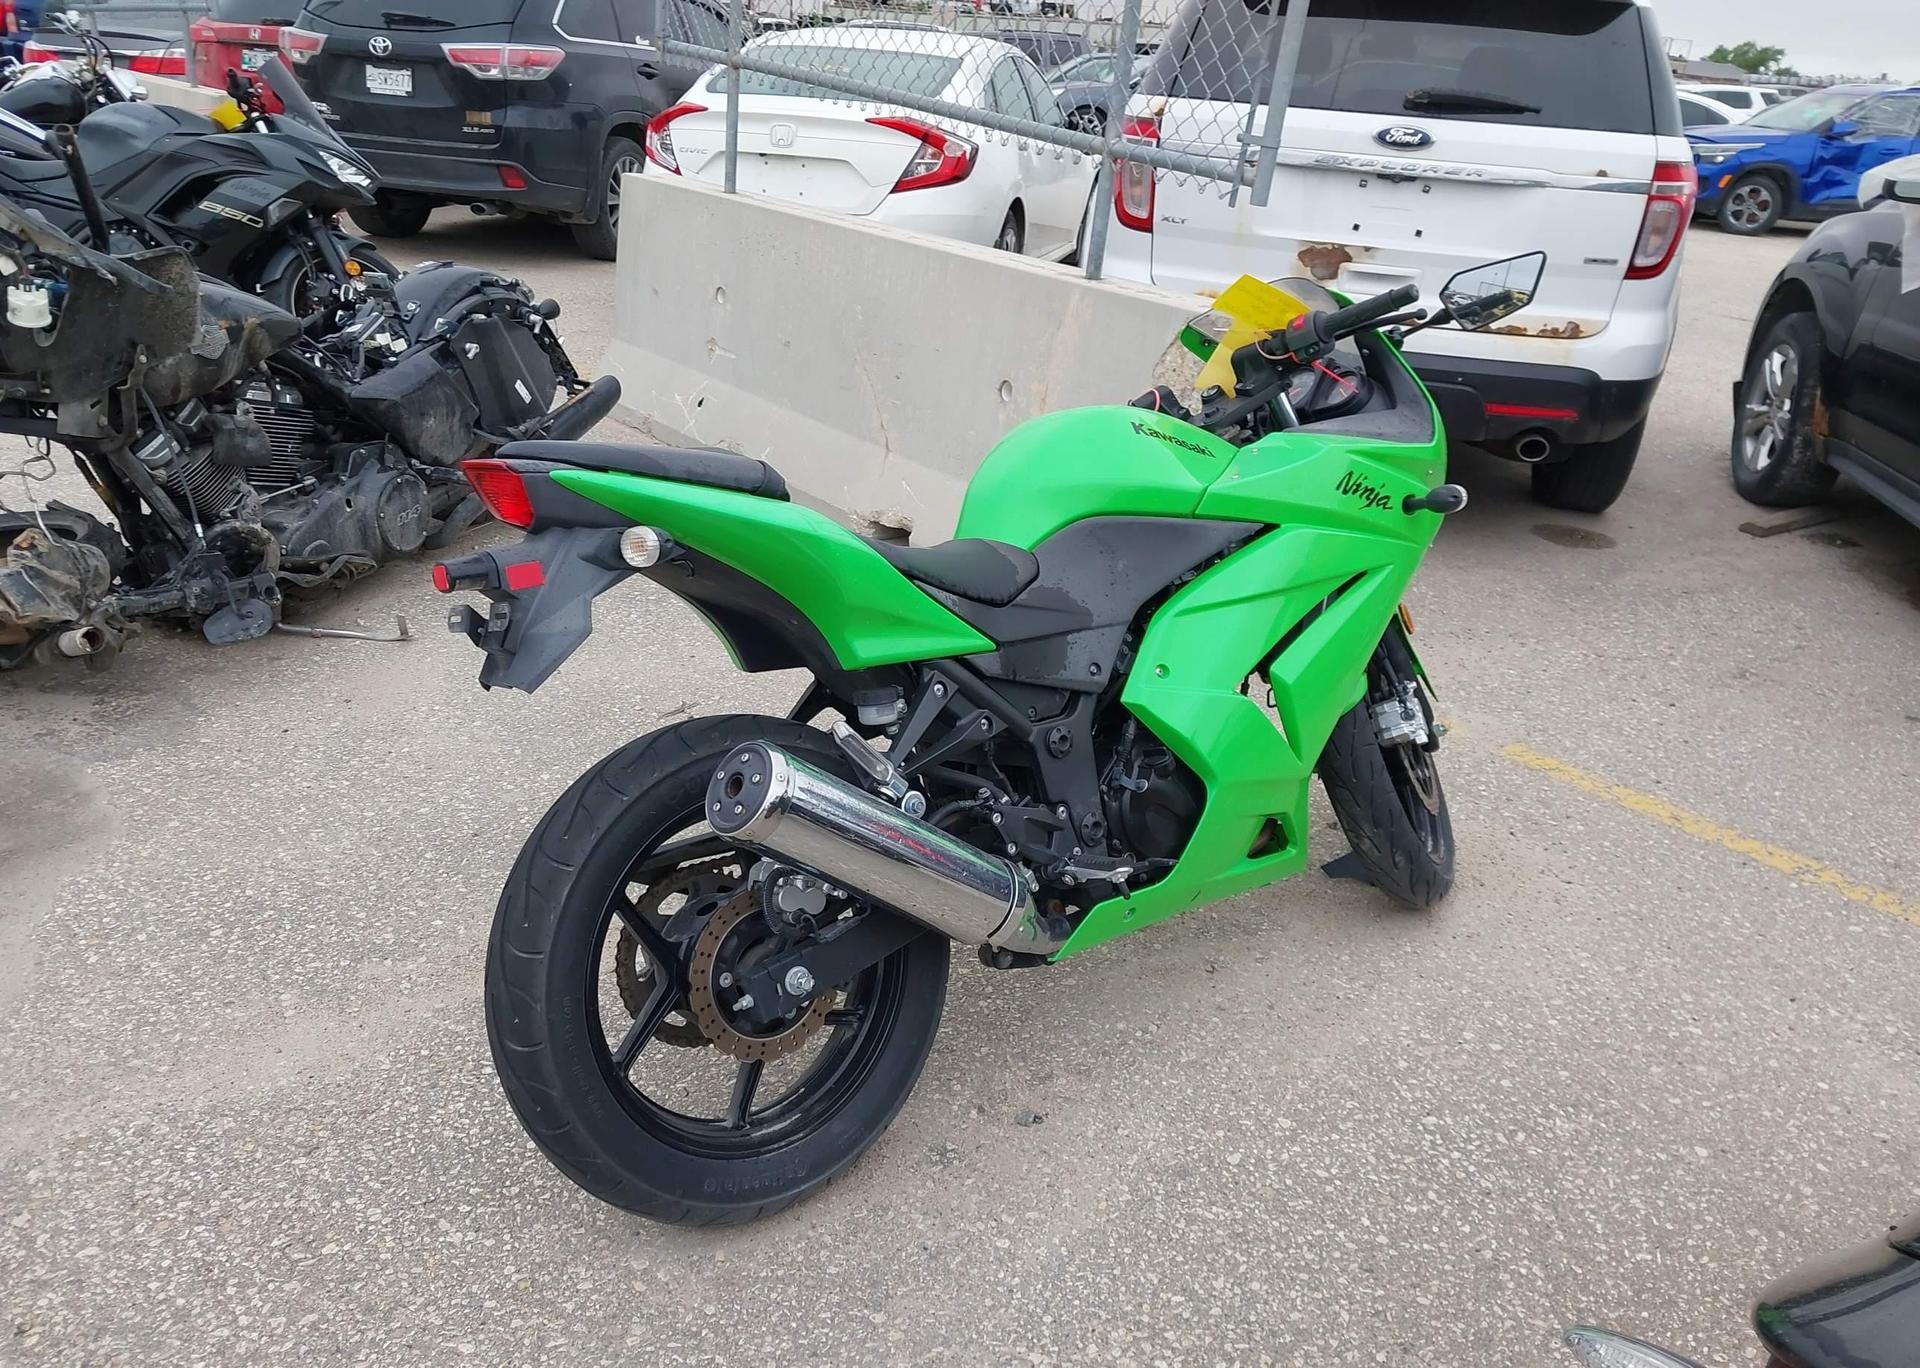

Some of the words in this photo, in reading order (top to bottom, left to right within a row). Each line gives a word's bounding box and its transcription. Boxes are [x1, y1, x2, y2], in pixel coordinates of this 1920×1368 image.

[1385, 127, 1422, 145] Ford
[679, 146, 709, 155] CIVIC
[1313, 154, 1489, 178] EXPLORER
[1160, 215, 1192, 225] XLT
[1130, 421, 1217, 459] Kawasaki
[1335, 469, 1394, 511] Ninja
